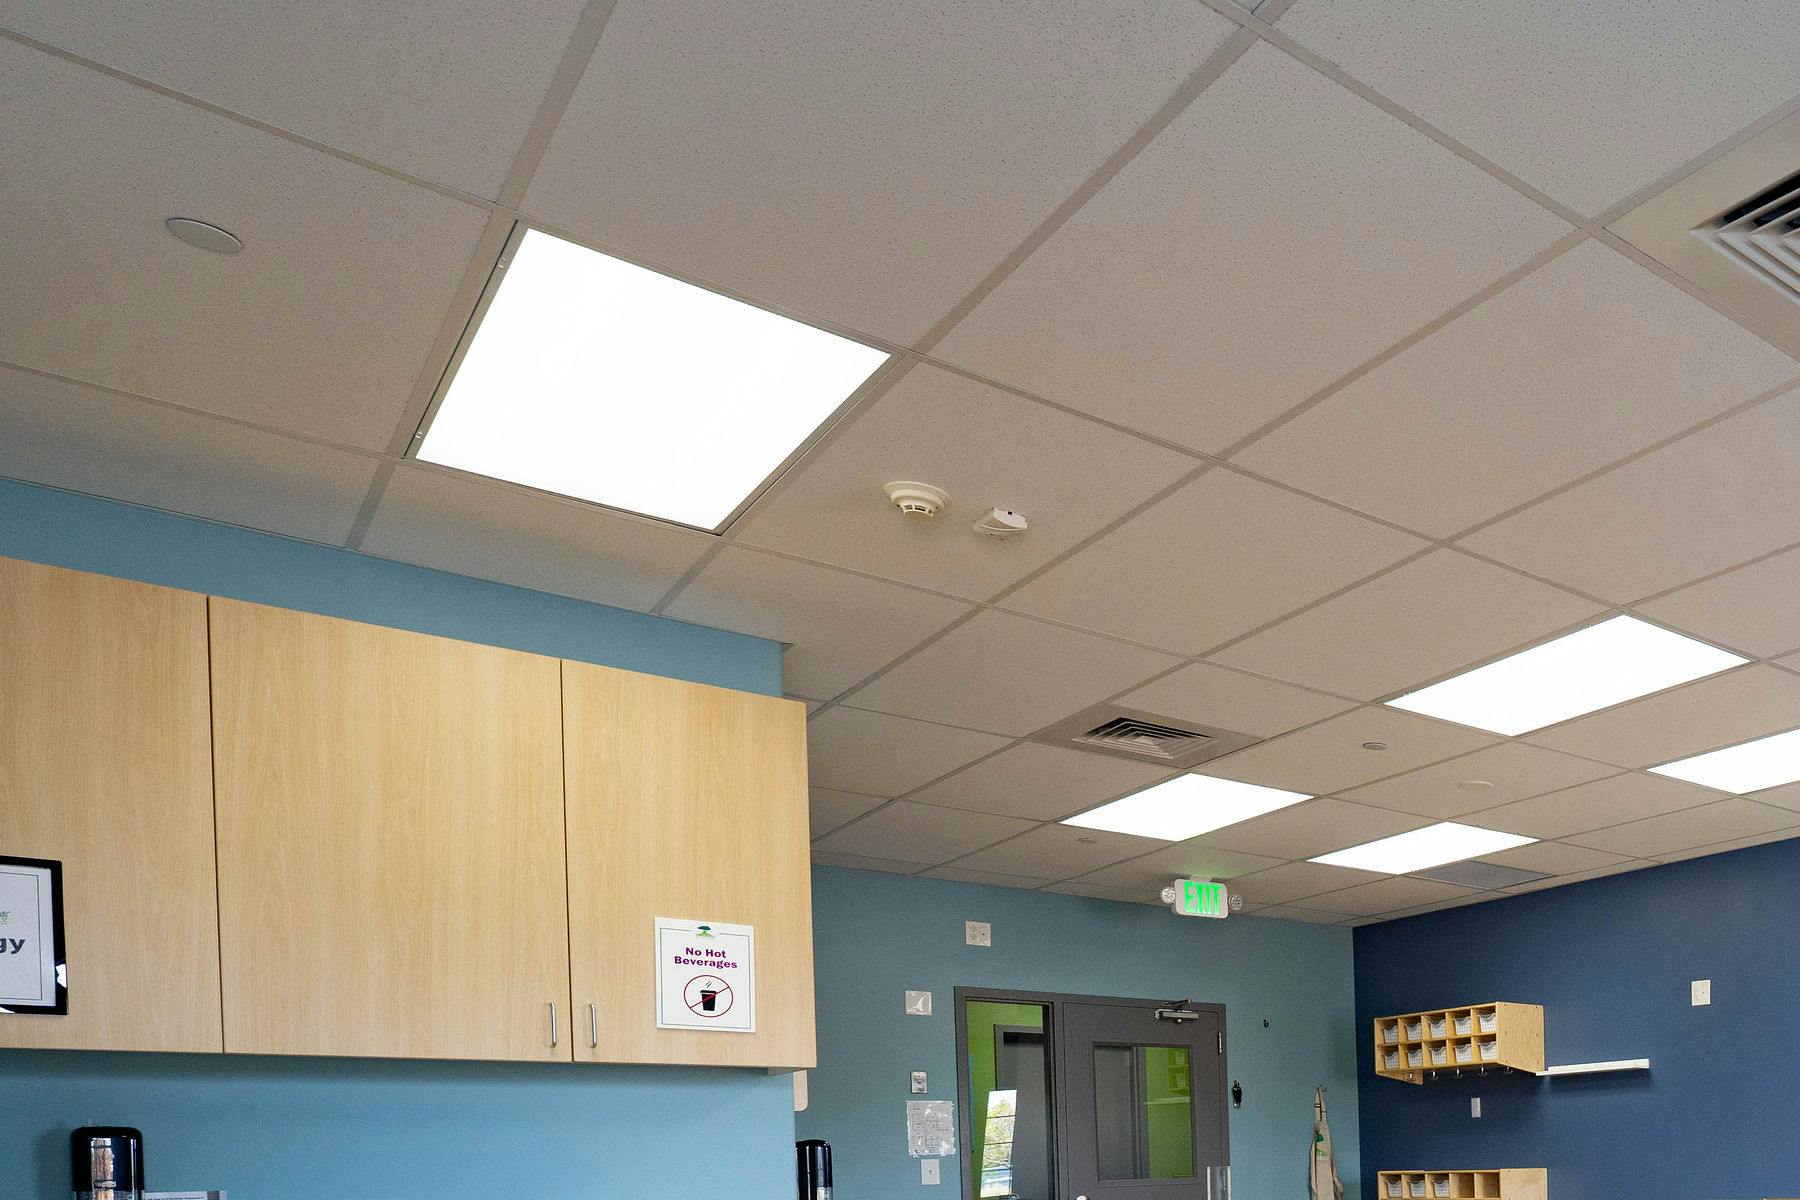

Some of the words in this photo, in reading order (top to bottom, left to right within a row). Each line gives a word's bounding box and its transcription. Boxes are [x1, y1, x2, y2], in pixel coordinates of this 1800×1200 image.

[1183, 881, 1221, 915] EXIT
[685, 947, 702, 957] No
[705, 948, 726, 958] Hot
[674, 956, 738, 969] Beverages
